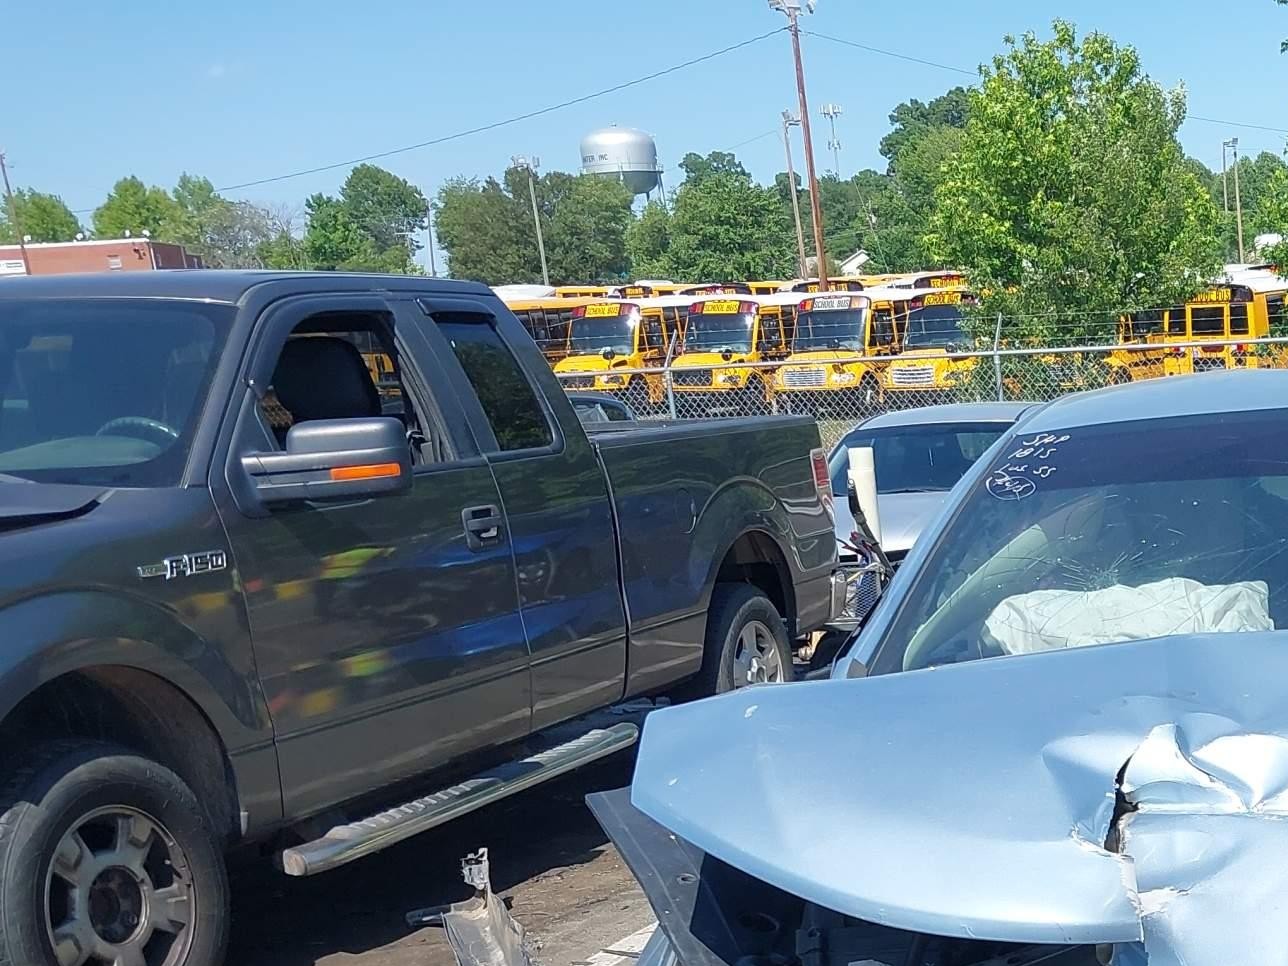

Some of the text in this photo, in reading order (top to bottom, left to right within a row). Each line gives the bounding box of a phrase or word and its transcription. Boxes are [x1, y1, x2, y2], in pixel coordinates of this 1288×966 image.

[1216, 289, 1230, 302] BUS
[704, 303, 738, 312] SCHOOL BUS
[813, 299, 850, 309] SCHOOL BUS
[587, 305, 619, 315] SCHOOL BUS
